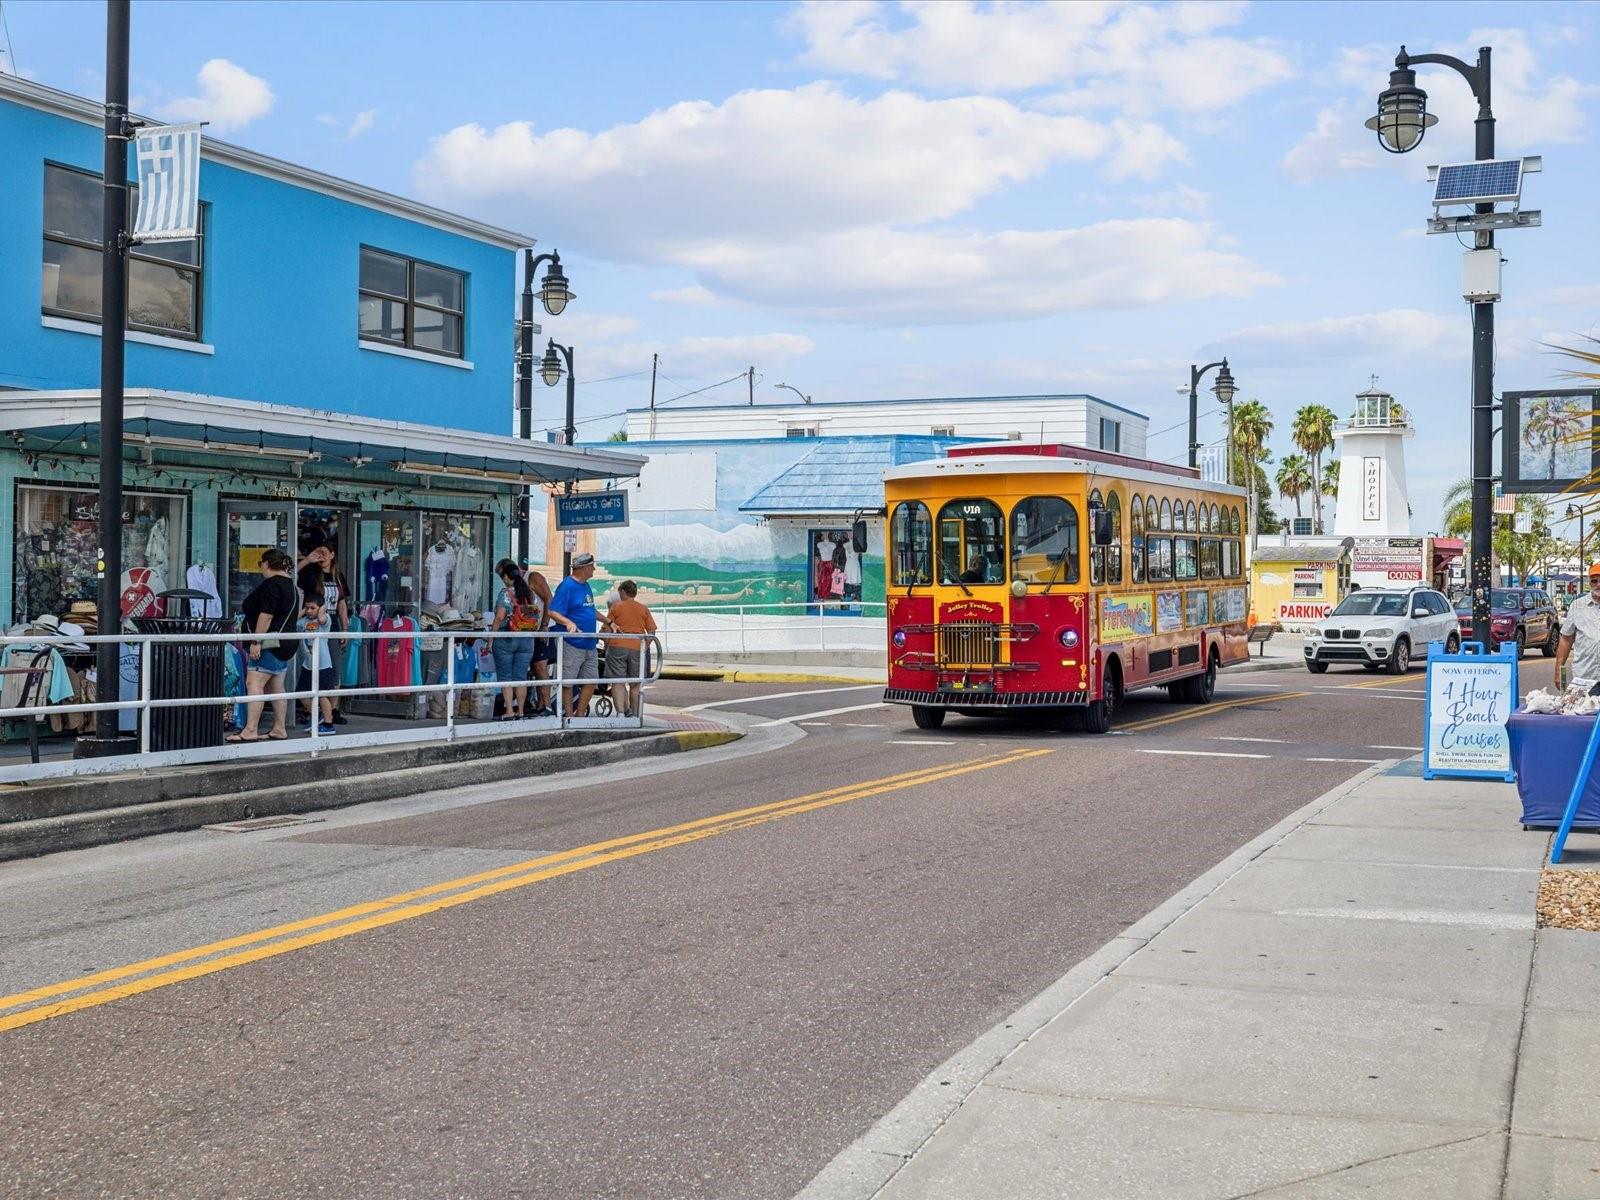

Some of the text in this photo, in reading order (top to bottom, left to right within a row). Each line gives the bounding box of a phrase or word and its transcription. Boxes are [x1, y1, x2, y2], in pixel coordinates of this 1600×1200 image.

[1368, 461, 1376, 517] SHOPPES
[562, 501, 597, 510] GLORIA'S
[963, 505, 981, 514] VIA
[1307, 561, 1336, 570] PARKING
[1390, 571, 1419, 580] COINS
[969, 602, 994, 613] Trolley
[1442, 677, 1503, 707] 4 Hour
[1446, 701, 1498, 727] Beach
[1441, 723, 1501, 750] Cruises
